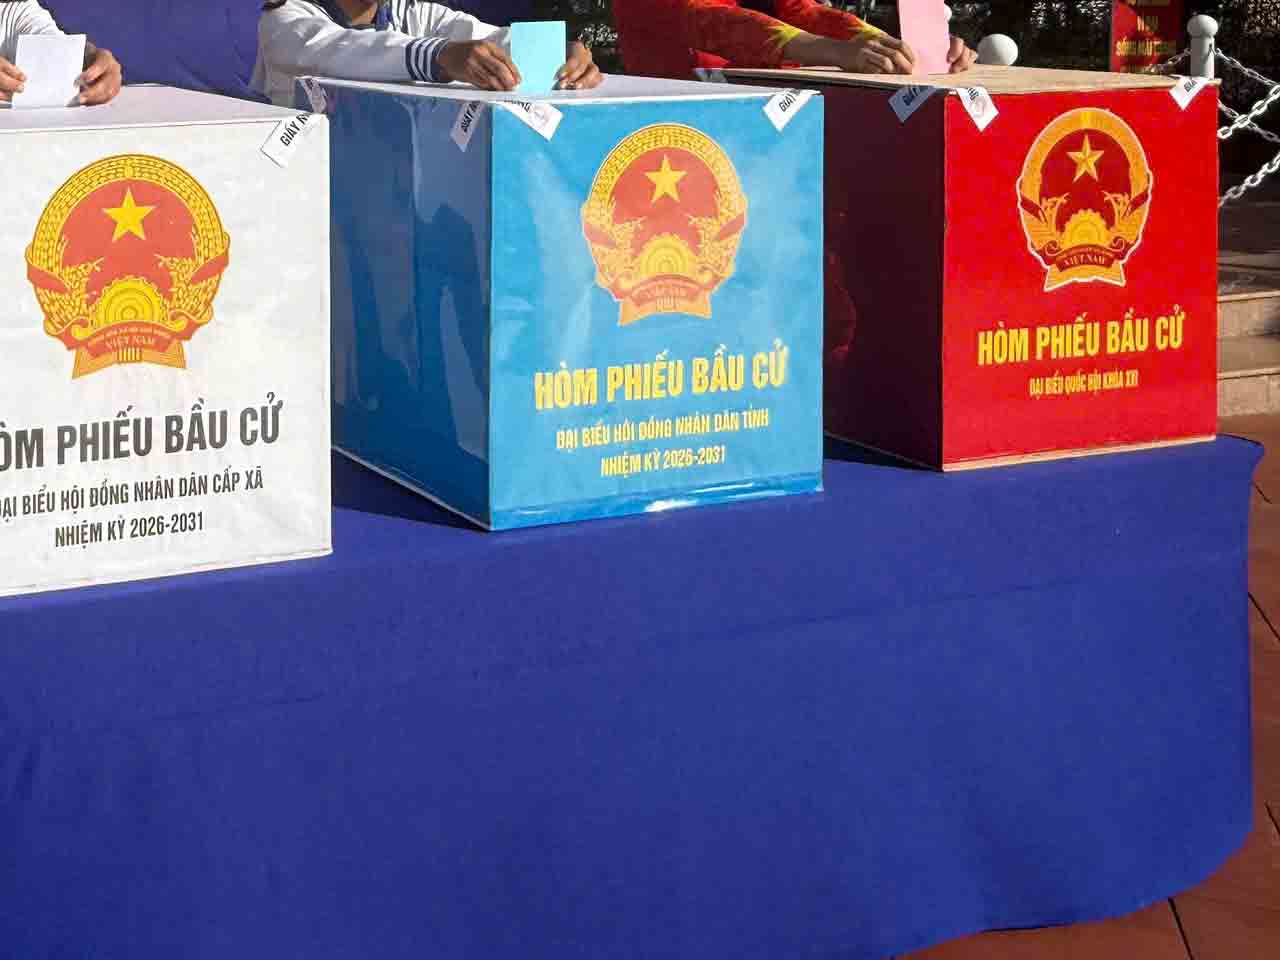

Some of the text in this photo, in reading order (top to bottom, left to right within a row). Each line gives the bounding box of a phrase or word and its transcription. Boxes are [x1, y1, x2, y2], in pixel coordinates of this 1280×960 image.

[977, 321, 1029, 365] HÒM
[1035, 312, 1100, 360] PHIẾU
[1155, 304, 1185, 351] CỬ
[534, 338, 789, 410] HÒM PHIẾU BẦU CỬ
[57, 405, 152, 465] PHIẾU
[165, 397, 228, 454] BẦU
[239, 391, 284, 447] CỬ
[22, 484, 55, 515] BIỂU
[61, 486, 85, 515] HỘI
[89, 478, 129, 509] ĐỒNG
[133, 475, 174, 502] NHÂN
[179, 474, 208, 498] DÂN
[213, 465, 240, 494] CẤP
[244, 465, 263, 490] XÃ
[601, 451, 641, 479] NHIỆM
[55, 511, 204, 549] NHIỆM KỲ 2026-2031
